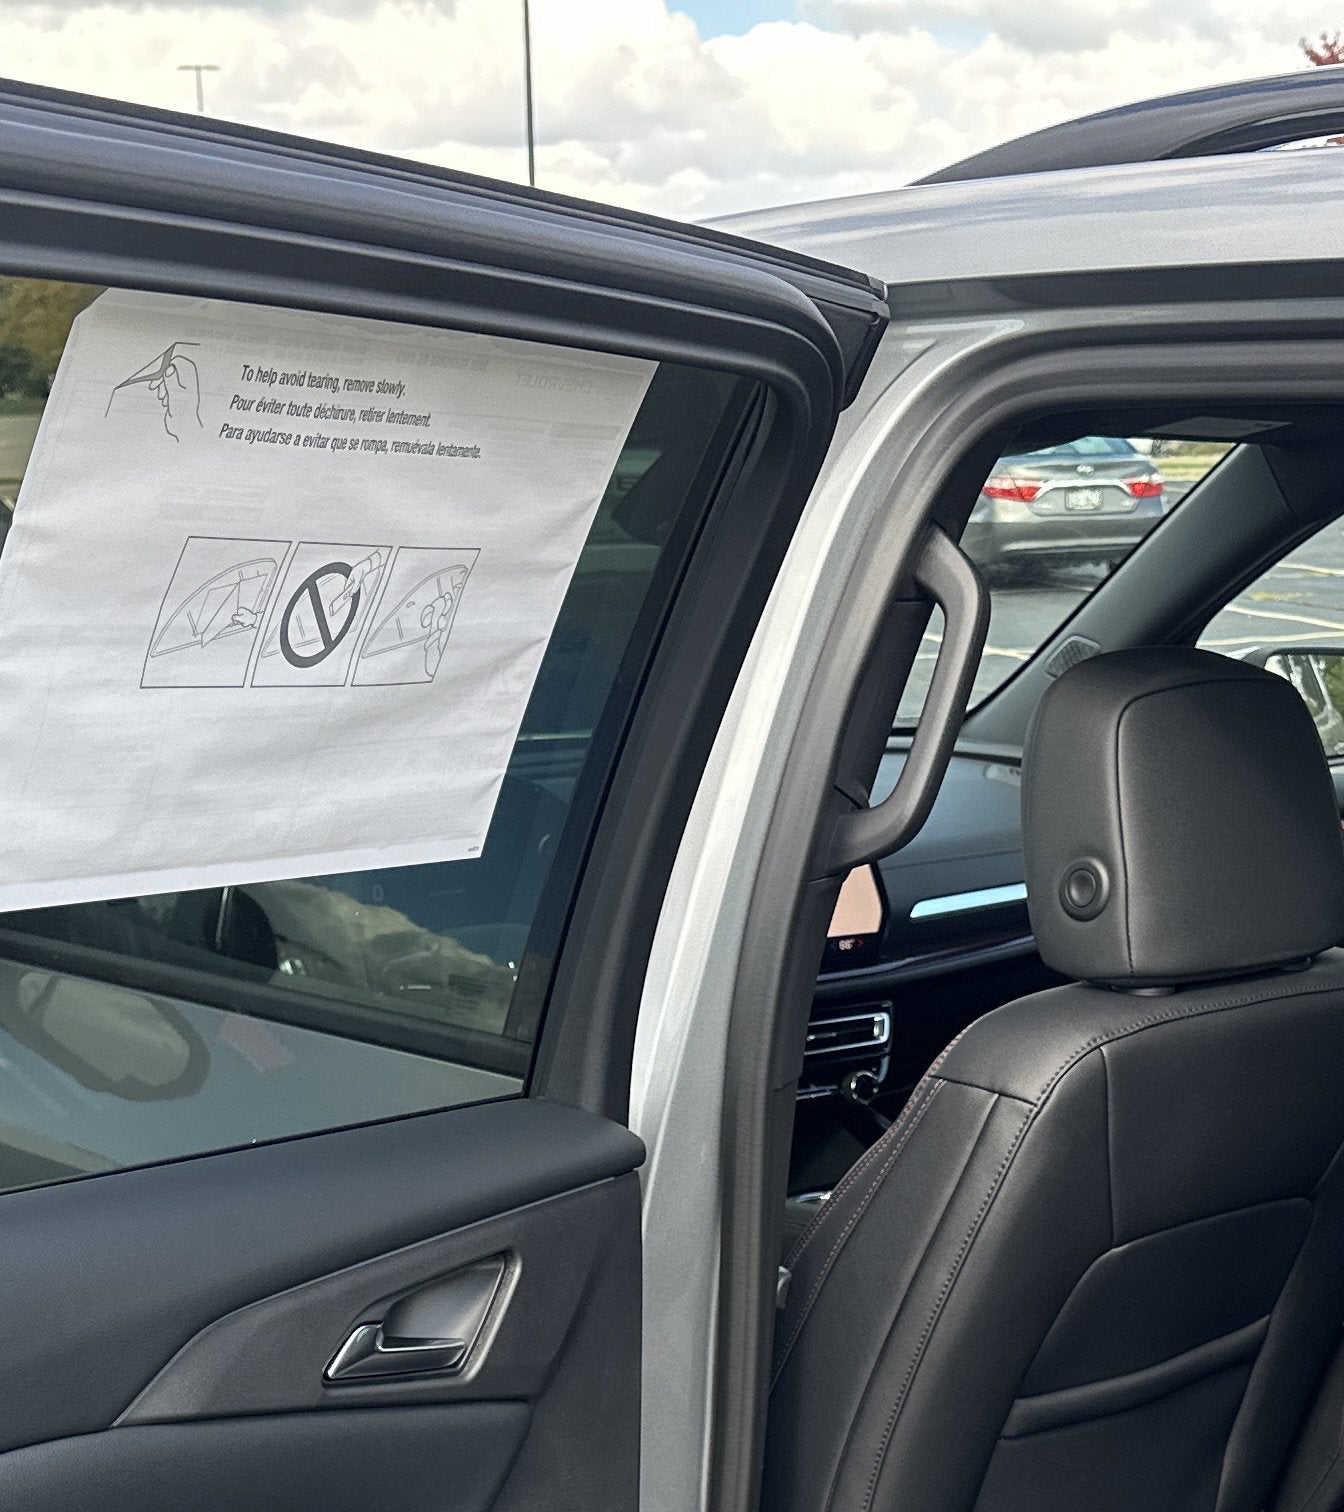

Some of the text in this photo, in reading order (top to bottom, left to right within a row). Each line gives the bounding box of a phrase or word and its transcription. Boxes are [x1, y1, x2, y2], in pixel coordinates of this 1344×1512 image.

[241, 364, 406, 400] To help avoid tearing, remove slowly.
[229, 394, 256, 412] Pour
[256, 396, 287, 415] éviter
[286, 400, 313, 419] toute
[313, 402, 357, 424] déchirure,
[358, 406, 386, 423] retirer
[218, 423, 245, 440] Para
[244, 427, 293, 445] ayudarse
[293, 433, 302, 447] a
[302, 432, 331, 449] evitar
[330, 436, 348, 453] que
[348, 438, 360, 451] se
[360, 438, 388, 455] rompa,
